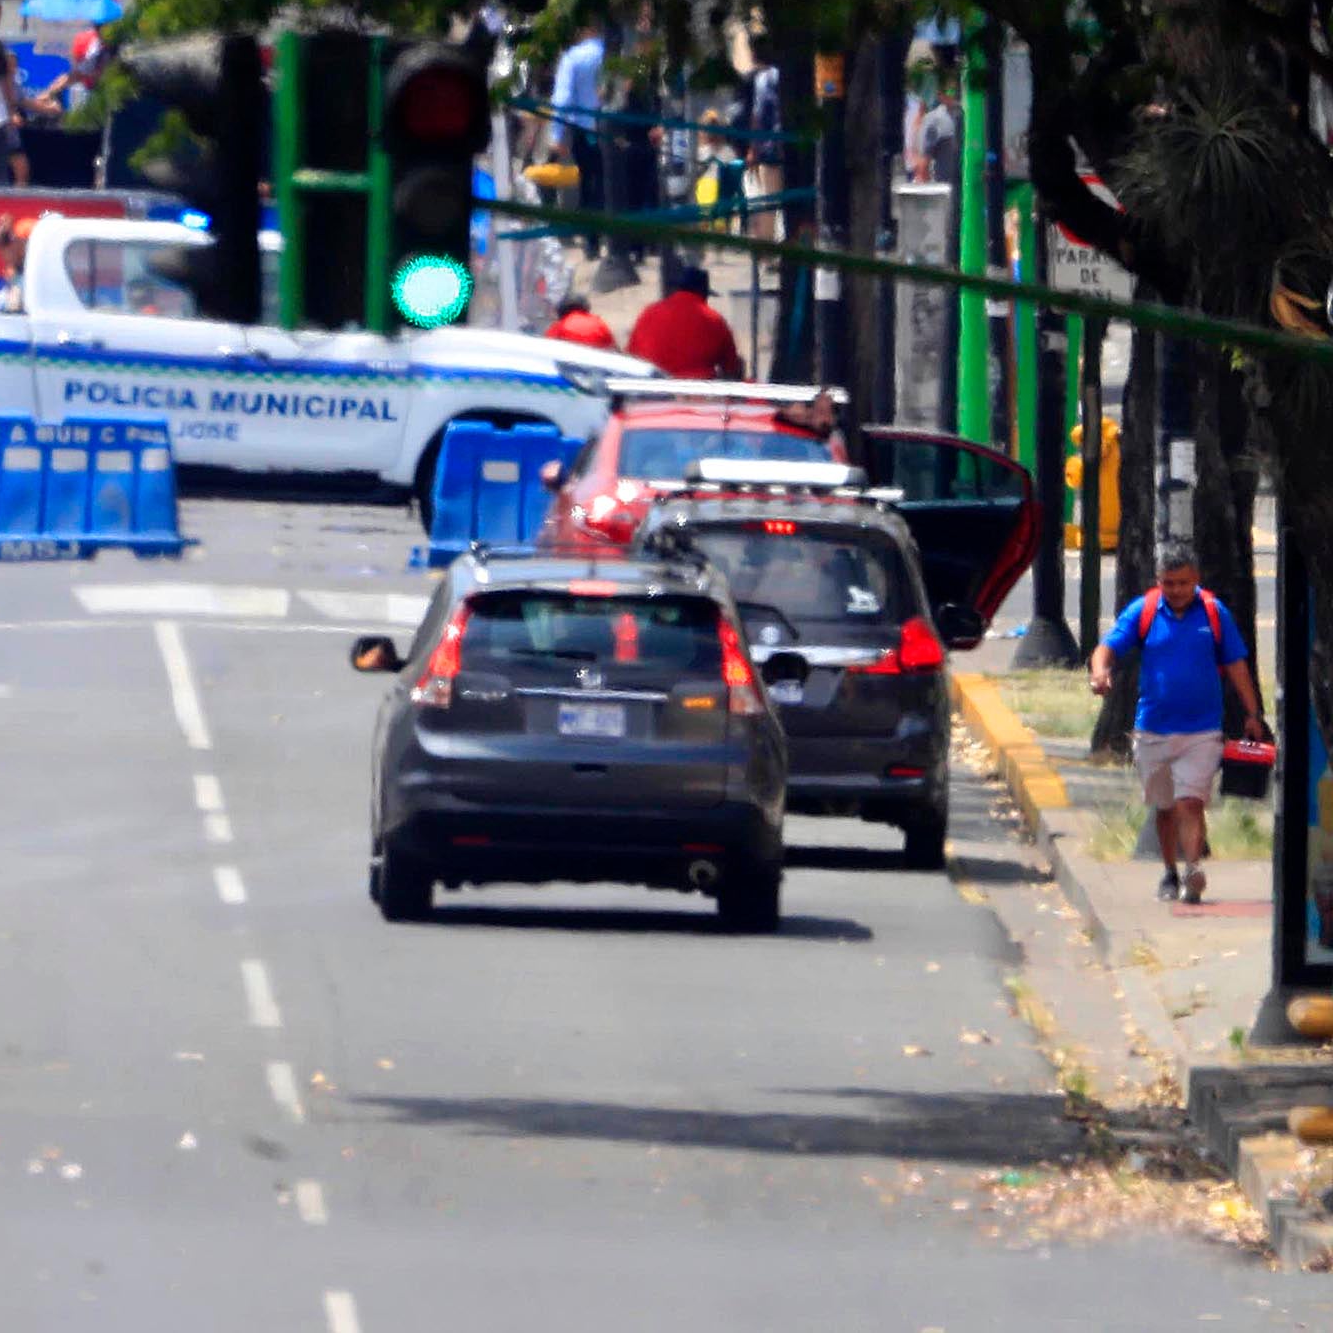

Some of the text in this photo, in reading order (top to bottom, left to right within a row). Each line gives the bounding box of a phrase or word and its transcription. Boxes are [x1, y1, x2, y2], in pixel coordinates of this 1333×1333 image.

[1079, 268, 1102, 284] DE
[63, 378, 399, 423] POLICIA MUNICIPAL
